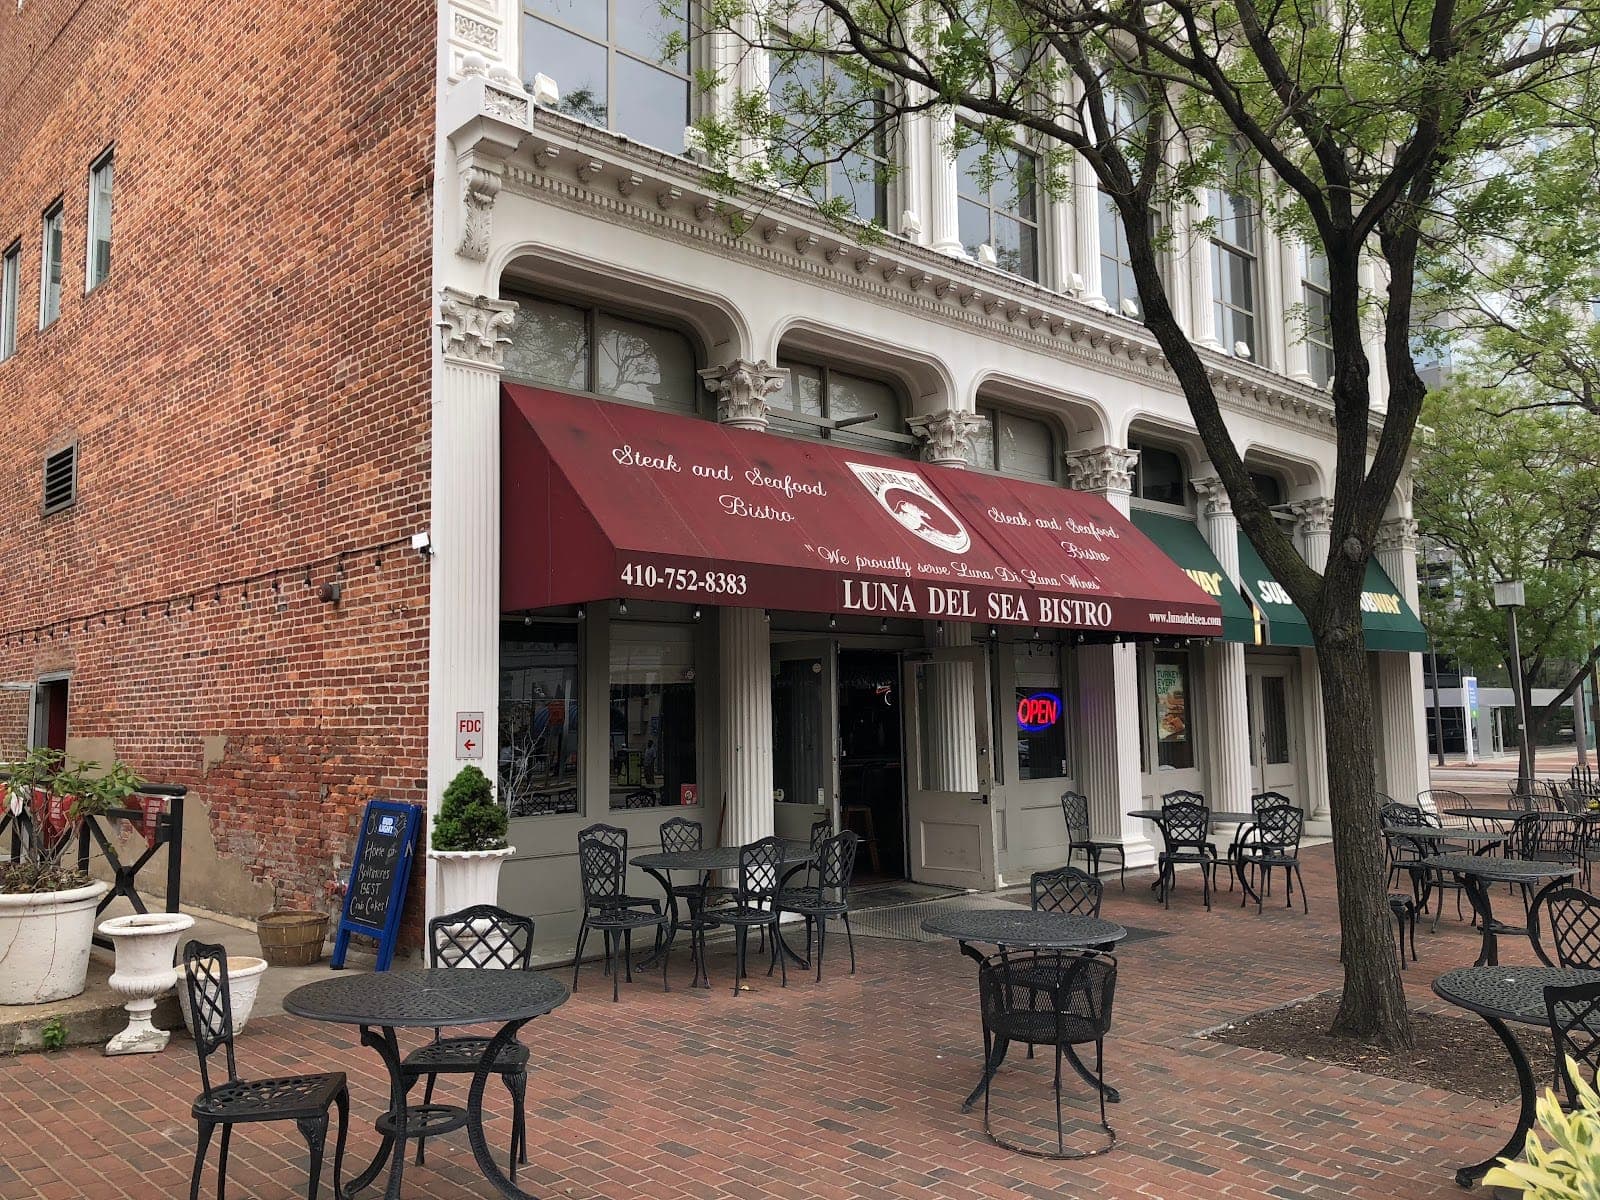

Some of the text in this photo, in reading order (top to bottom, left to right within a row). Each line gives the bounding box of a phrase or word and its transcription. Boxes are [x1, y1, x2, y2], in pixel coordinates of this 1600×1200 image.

[612, 445, 827, 499] Steak and Seafood
[718, 494, 795, 522] Bistro
[987, 506, 1120, 542] Steak and Seafood
[1060, 541, 1111, 562] Bistro
[620, 563, 748, 595] 410-752-8383
[856, 555, 912, 577] proudly
[918, 562, 950, 576] serve
[951, 561, 994, 580] Luna
[995, 566, 1022, 583] Di
[1021, 569, 1061, 586] Luna
[1181, 568, 1222, 596] WAY
[842, 579, 1112, 627] LUNA DEL SEA BISTRO
[1257, 580, 1293, 605] SUB
[1360, 591, 1402, 614] UBWAY
[1148, 611, 1222, 626] www.lunadelsea.com
[1157, 679, 1177, 688] EVERY
[1018, 698, 1057, 725] OPEN
[459, 719, 481, 733] FDC
[378, 824, 394, 834] LIGHT
[382, 816, 394, 826] BUD
[365, 840, 385, 862] Home
[360, 882, 382, 896] BEST
